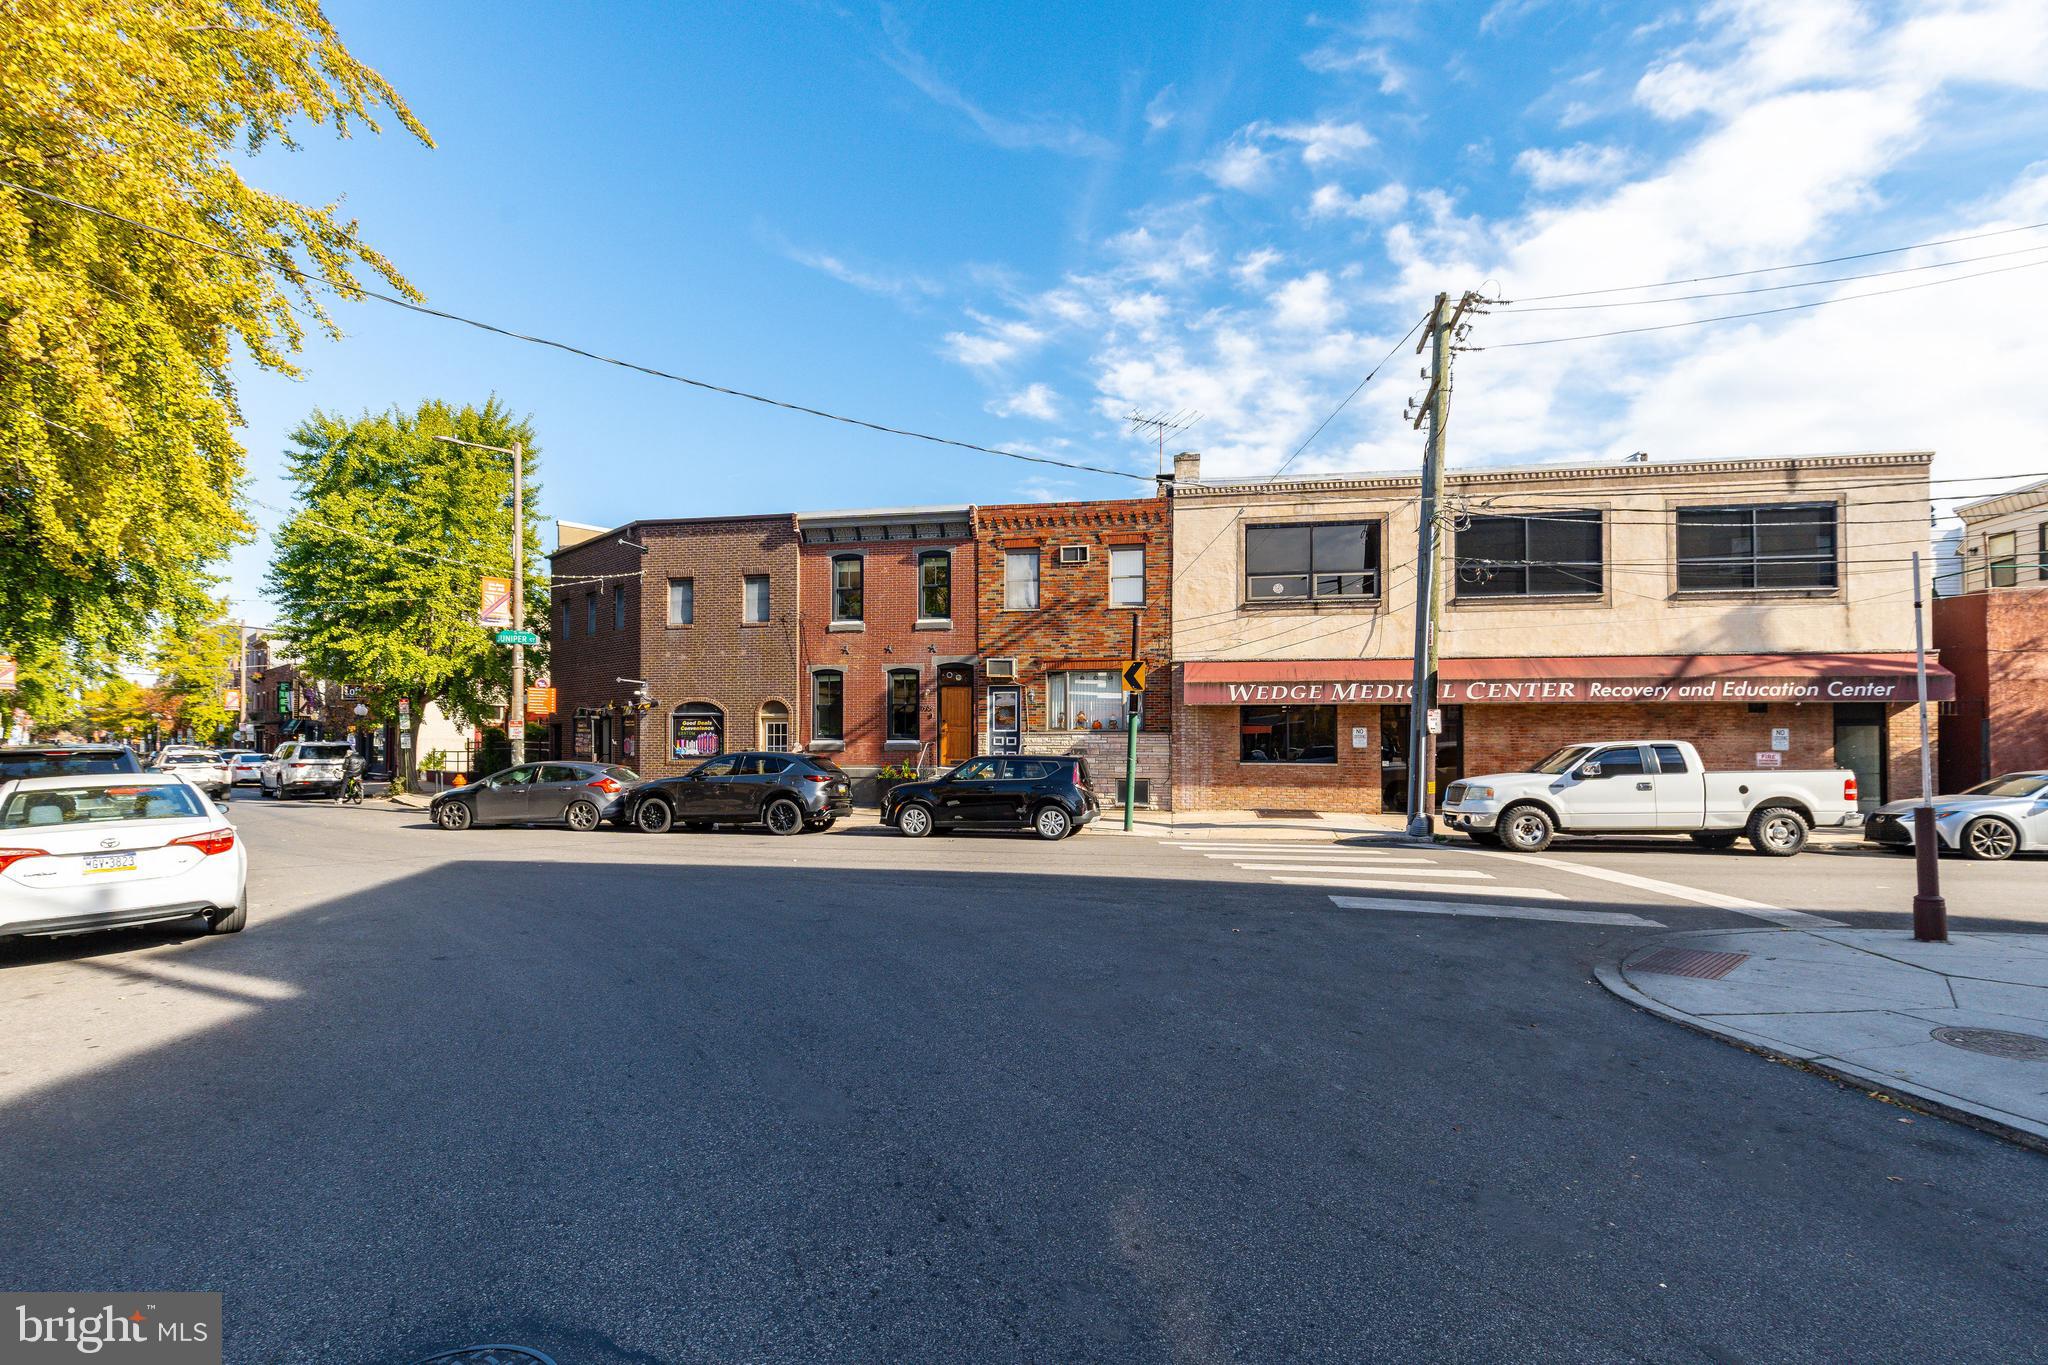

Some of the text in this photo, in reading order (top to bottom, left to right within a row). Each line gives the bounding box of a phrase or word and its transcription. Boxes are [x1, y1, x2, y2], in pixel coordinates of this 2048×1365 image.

[496, 635, 527, 643] JUNIPER
[1228, 684, 1323, 701] WEDGE
[1466, 682, 1575, 700] CENTER
[1590, 682, 1672, 701] Recovery
[1678, 680, 1716, 697] and
[1723, 680, 1819, 697] Education
[1827, 681, 1896, 697] Center
